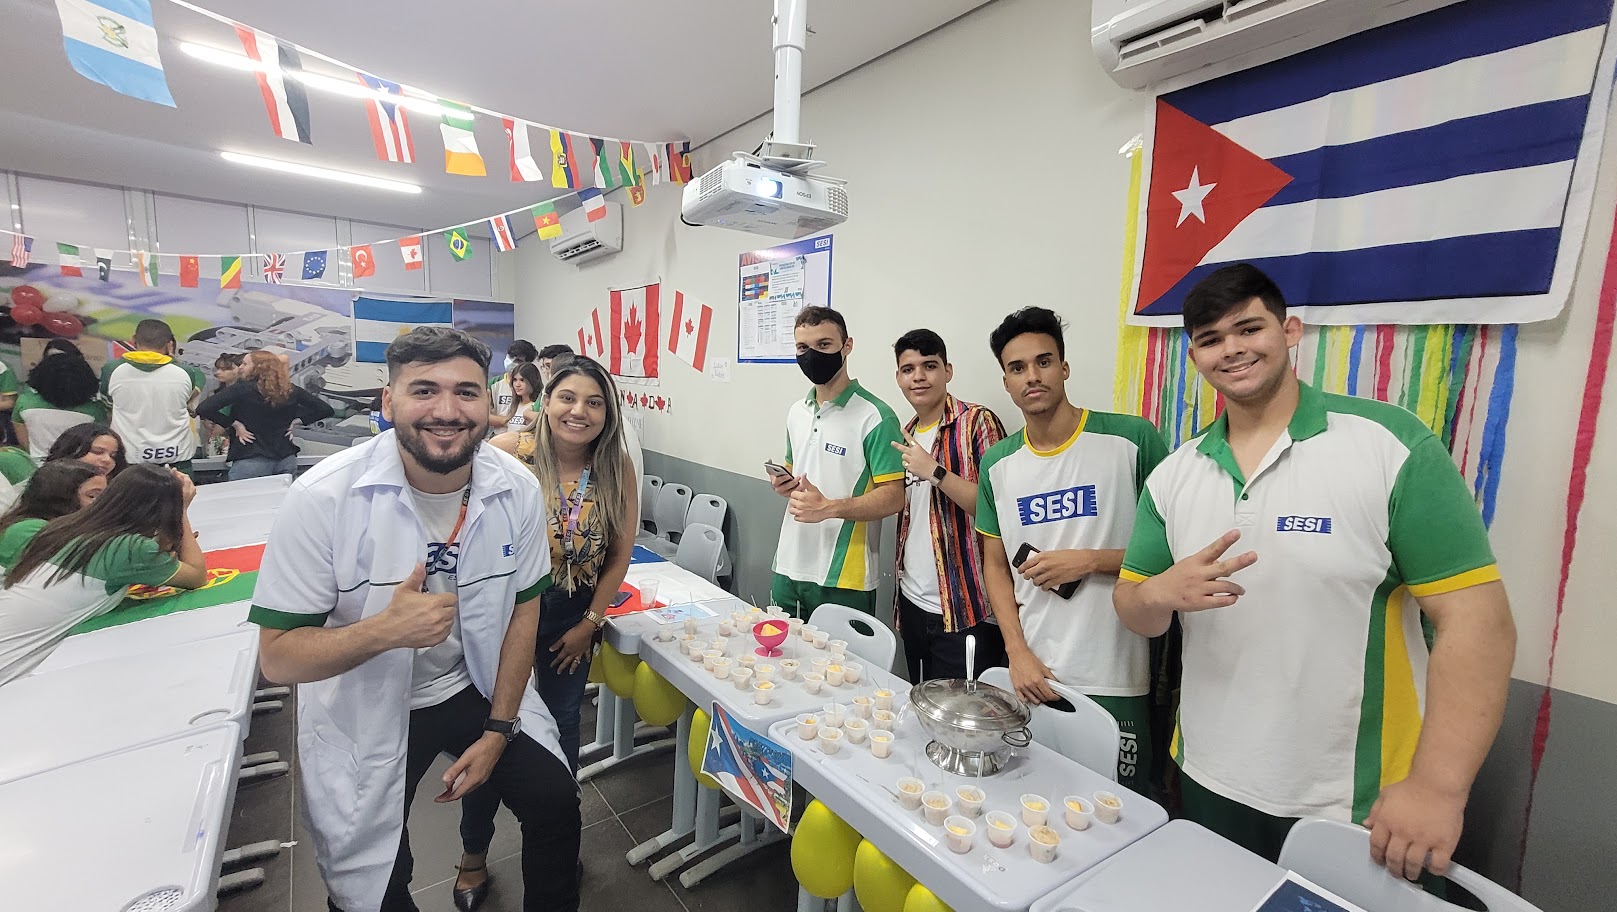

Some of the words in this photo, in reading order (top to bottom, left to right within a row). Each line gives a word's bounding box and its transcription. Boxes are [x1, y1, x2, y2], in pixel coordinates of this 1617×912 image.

[816, 239, 829, 247] SESI
[142, 445, 179, 460] SESI
[826, 444, 843, 455] SESI
[1029, 489, 1084, 523] SESI
[1283, 516, 1323, 532] SESI
[1119, 731, 1138, 777] SESI
